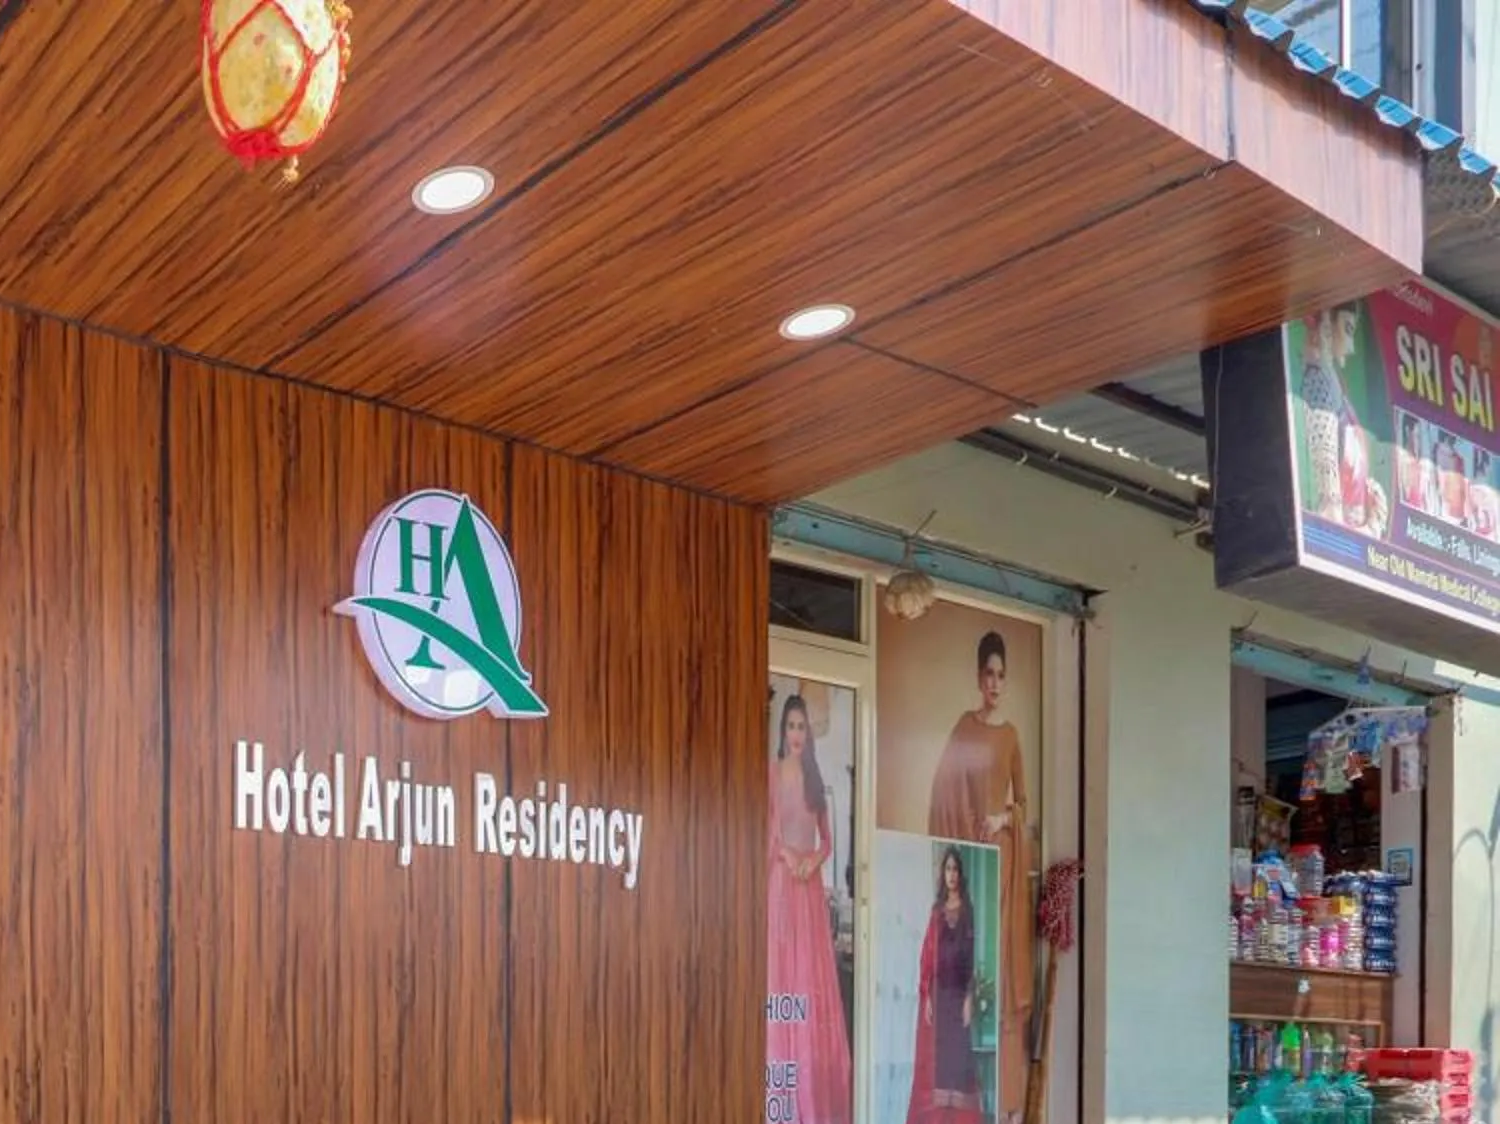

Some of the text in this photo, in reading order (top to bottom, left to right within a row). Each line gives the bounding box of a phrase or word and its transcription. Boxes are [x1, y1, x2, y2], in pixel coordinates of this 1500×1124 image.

[1396, 325, 1494, 432] SRI SAI
[235, 740, 644, 890] Hotel Arjun Residency
